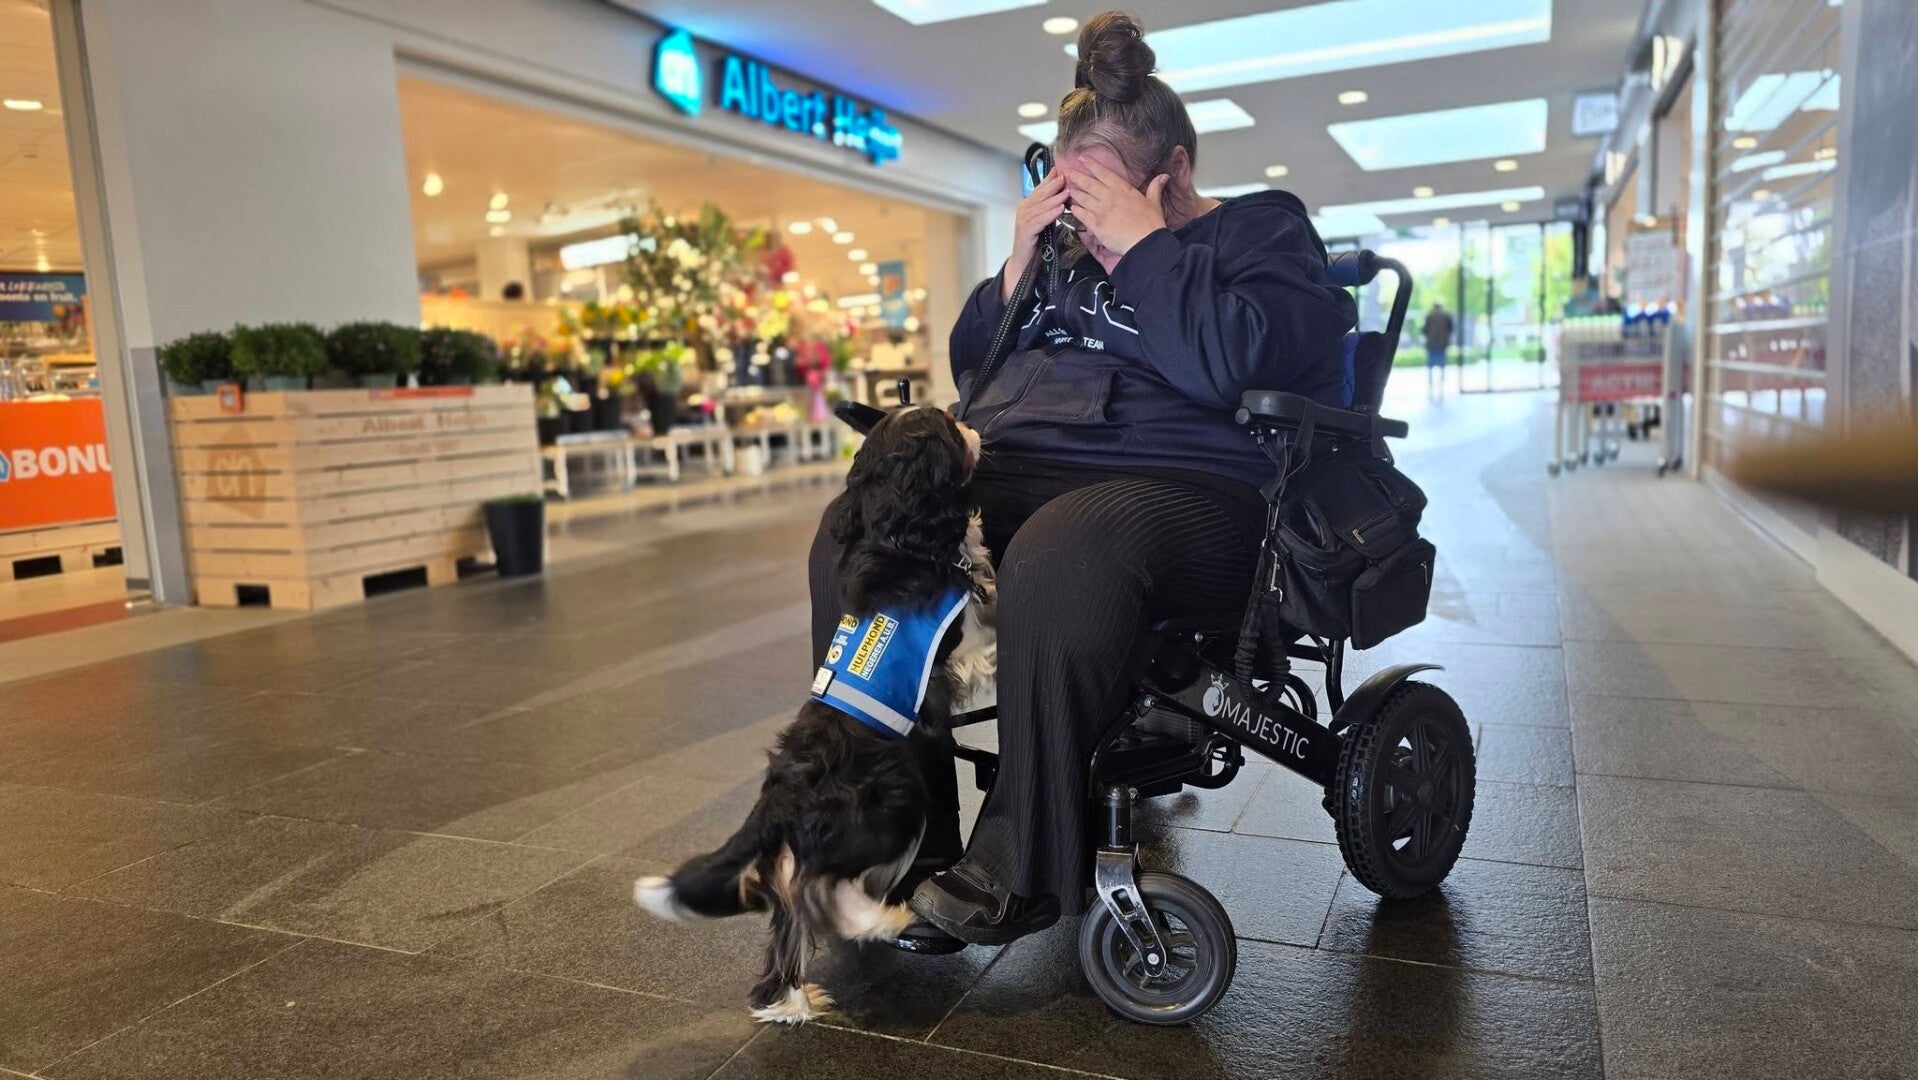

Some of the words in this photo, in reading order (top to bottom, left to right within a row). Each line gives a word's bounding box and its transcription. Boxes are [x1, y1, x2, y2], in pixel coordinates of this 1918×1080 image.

[721, 54, 827, 138] Albert
[1082, 336, 1105, 350] TEAM
[850, 615, 885, 672] HULPHOND
[860, 641, 884, 678] NEGEREN
[1221, 696, 1310, 760] MAJESTIC
